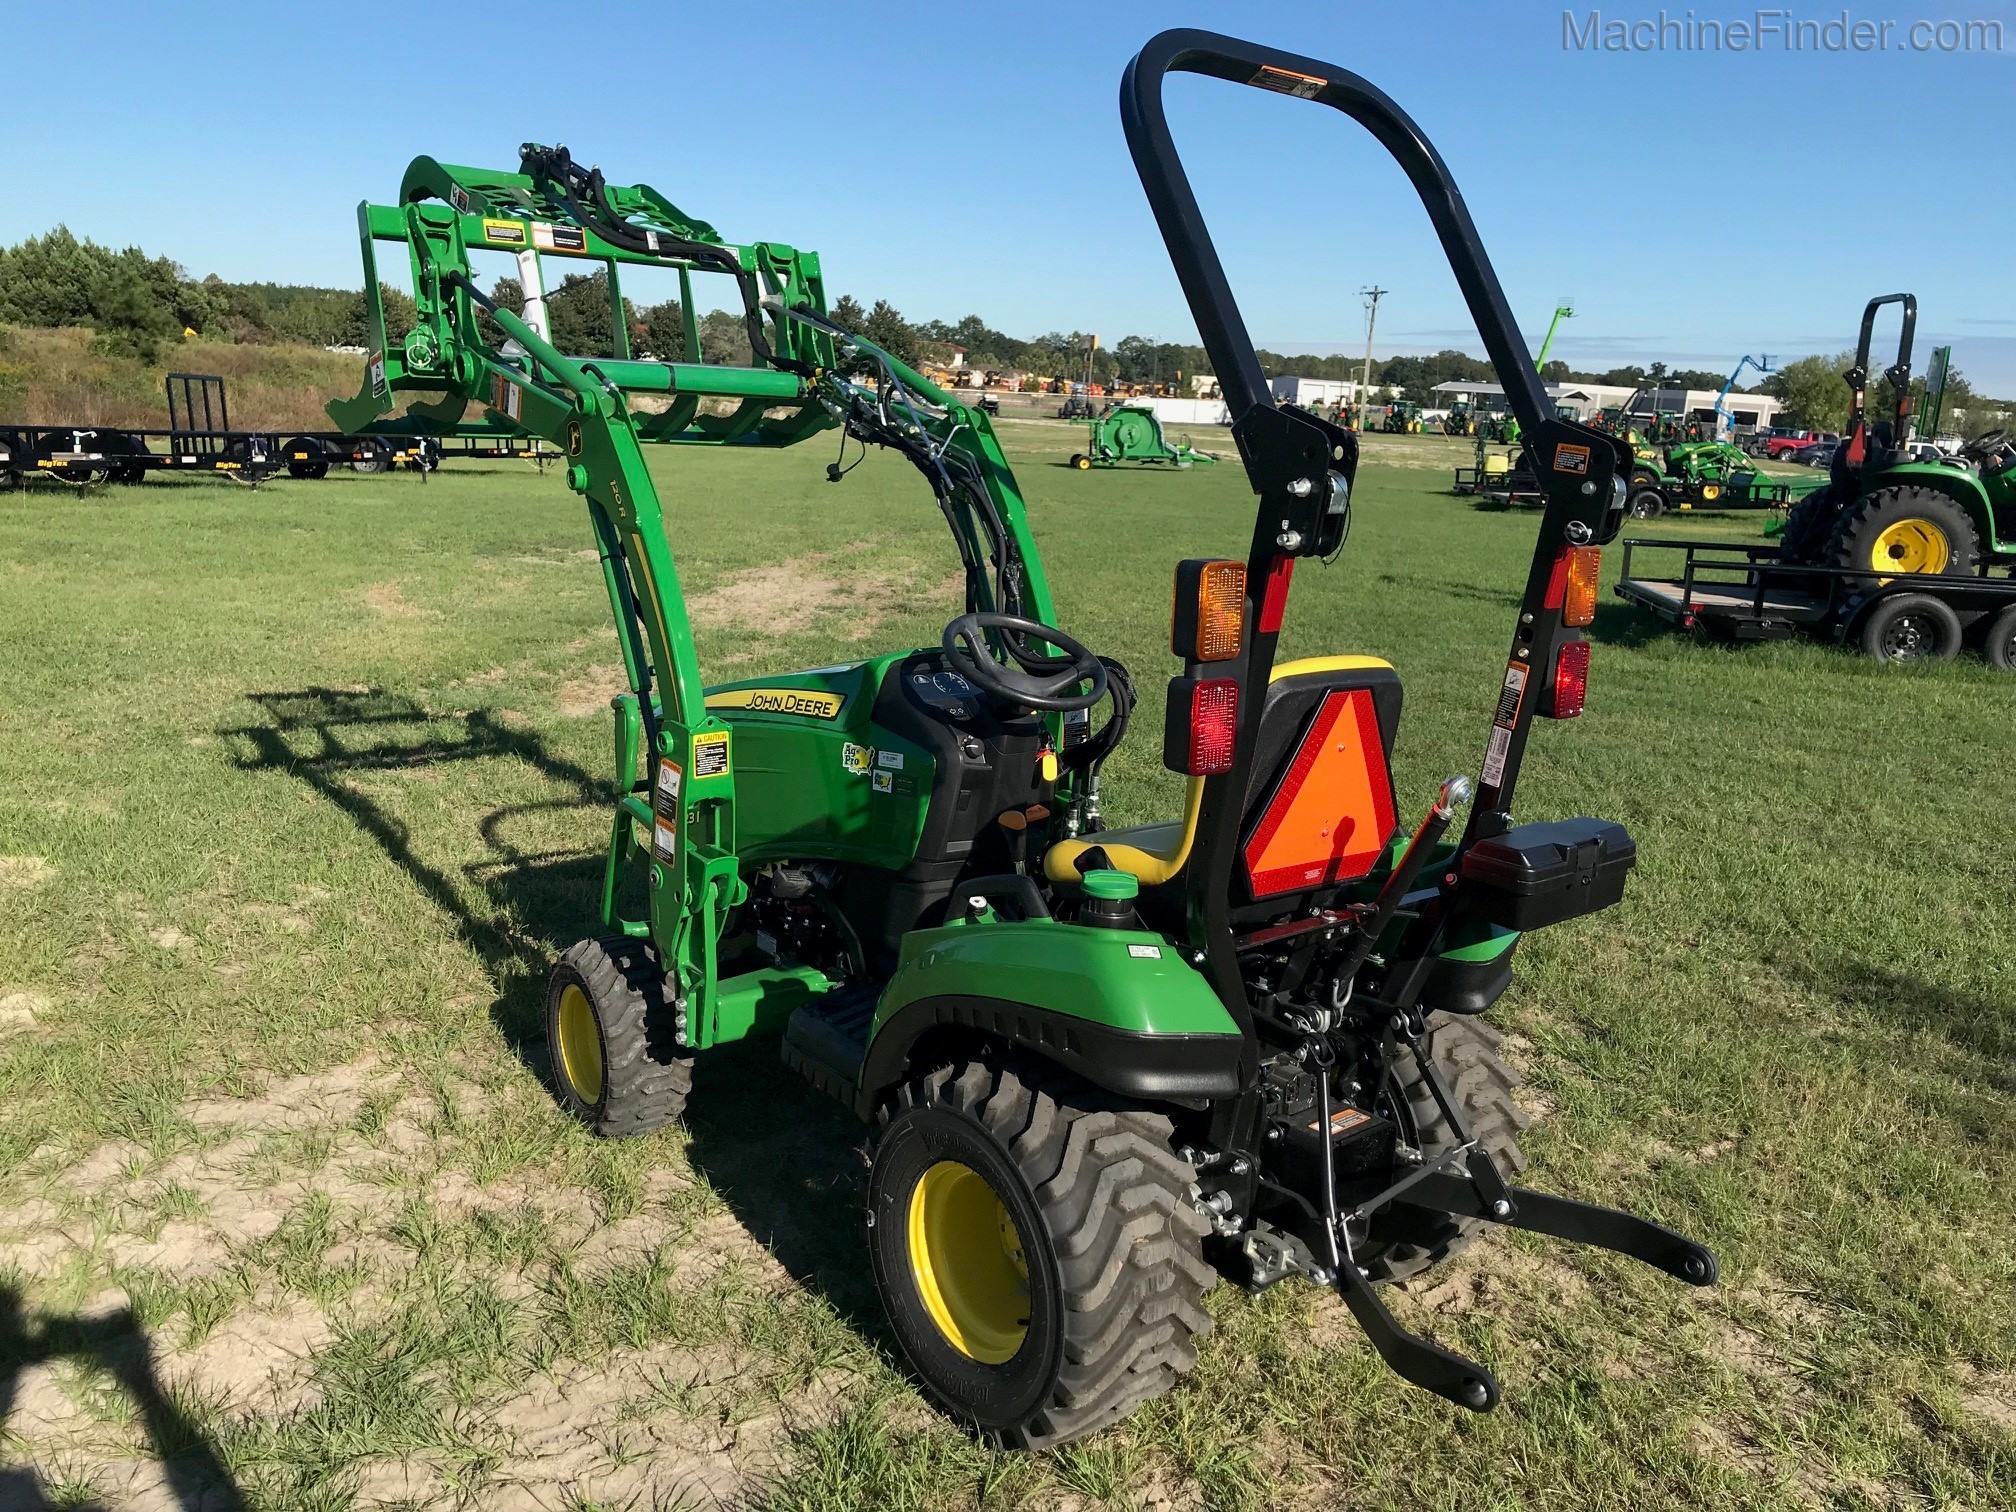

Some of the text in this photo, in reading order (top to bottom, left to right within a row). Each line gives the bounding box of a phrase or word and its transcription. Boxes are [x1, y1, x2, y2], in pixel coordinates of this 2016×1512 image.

[746, 692, 834, 716] JOHN DEERE
[703, 733, 727, 743] CAUTION
[844, 755, 860, 766] Pro
